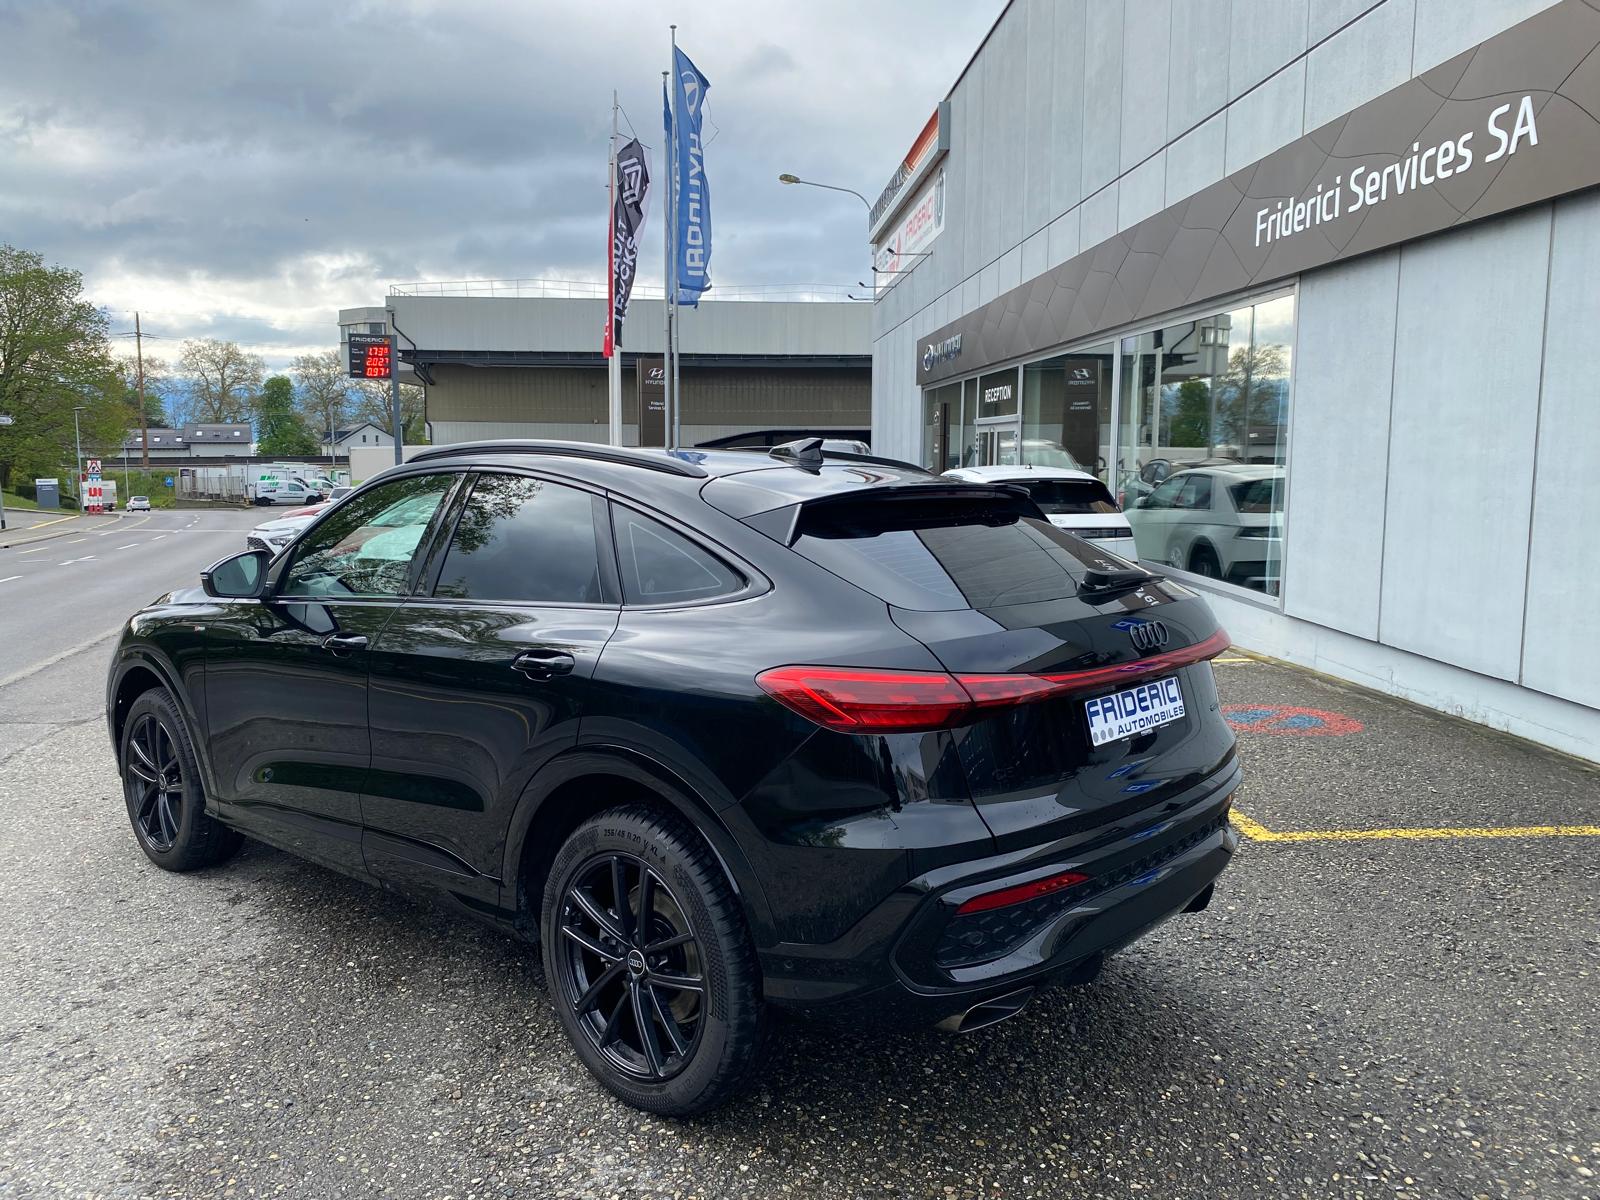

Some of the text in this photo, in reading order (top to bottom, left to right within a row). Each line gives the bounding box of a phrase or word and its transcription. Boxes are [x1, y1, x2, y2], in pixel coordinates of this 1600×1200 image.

[1255, 95, 1539, 247] Friderici Services SA
[984, 385, 1012, 403] RECEPTION
[1086, 678, 1182, 728] FRIDERICI
[1118, 705, 1184, 736] AUTOMOBILES
